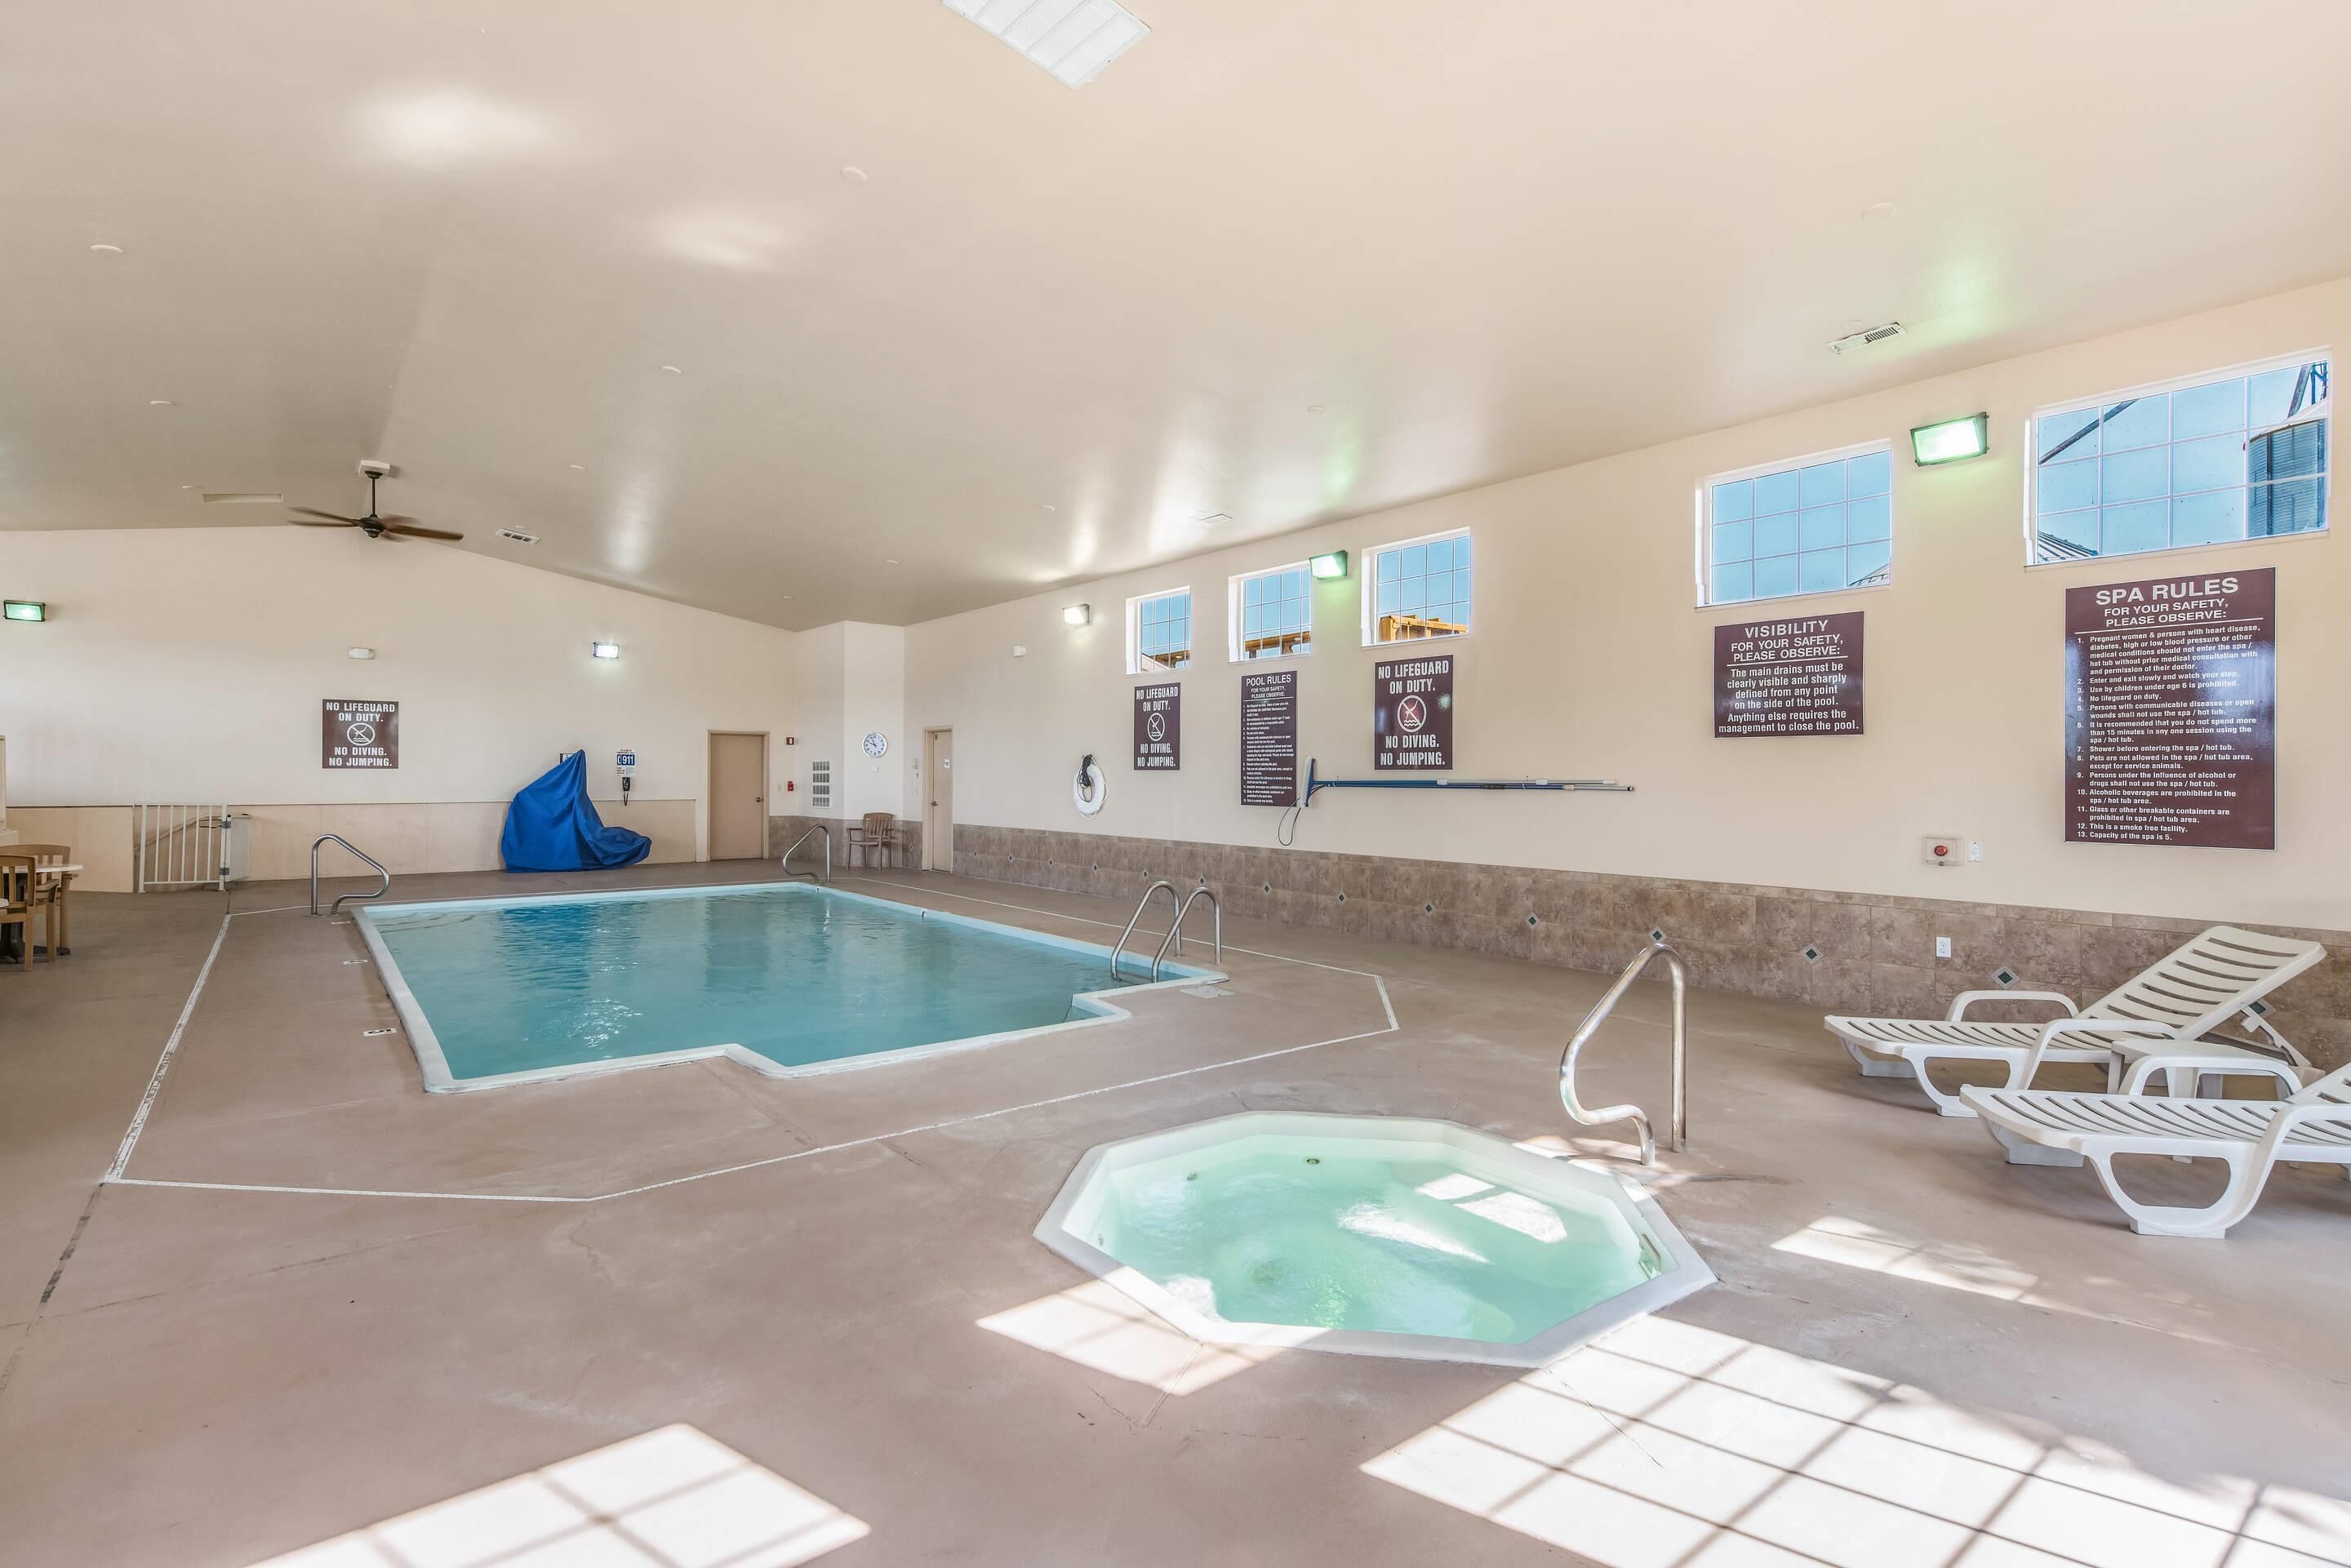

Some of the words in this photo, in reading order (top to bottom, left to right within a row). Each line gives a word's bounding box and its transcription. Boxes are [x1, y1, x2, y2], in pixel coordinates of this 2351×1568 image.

[2095, 587, 2144, 605] SPA
[2153, 577, 2238, 600] RULES
[2104, 607, 2129, 617] FOR
[2133, 603, 2169, 614] YOUR
[2173, 598, 2228, 611] SAFETY,
[2106, 615, 2155, 627] PLEASE
[2158, 610, 2226, 623] OBSERVE:
[1744, 620, 1829, 638] VISIBILITY
[2090, 634, 2120, 642] Pregnant
[2157, 630, 2185, 638] persons
[1731, 642, 1753, 652] FOR
[1758, 638, 1789, 650] YOUR
[1794, 633, 1843, 646] SAFETY,
[2187, 637, 2220, 645] pressure
[1734, 651, 1775, 662] PLEASE
[1780, 645, 1840, 659] OBSERVE:
[1378, 665, 1390, 679] NO
[1395, 660, 1449, 677] LIFEGUARD
[1731, 669, 1746, 677] The
[1749, 667, 1771, 677] main
[1774, 664, 1802, 675] drains
[1806, 663, 1829, 673] must
[1832, 662, 1843, 671] be
[2104, 666, 2143, 675] permission
[1247, 677, 1265, 686] POOL
[1267, 674, 1291, 685] RULES
[1389, 681, 1402, 694] ON
[1407, 678, 1435, 693] DUTY.
[1727, 678, 1756, 689] clearly
[1758, 677, 1789, 686] visible
[1791, 675, 1808, 685] and
[1811, 673, 1847, 685] sharply
[1136, 690, 1144, 700] NO
[1146, 686, 1178, 699] LIFEGUARD
[1735, 688, 1767, 700] defined
[1771, 688, 1791, 697] from
[1794, 688, 1811, 697] any
[1814, 684, 1838, 696] point
[2101, 694, 2131, 702] lifeguard
[327, 702, 340, 711] NO
[344, 703, 395, 713] LIFEGUARD
[1143, 701, 1151, 712] ON
[1153, 700, 1171, 711] DUTY.
[1748, 700, 1761, 708] the
[1763, 699, 1783, 708] side
[1785, 698, 1794, 707] of
[1797, 698, 1811, 707] the
[1815, 696, 1838, 708] pool.
[339, 713, 352, 722] ON
[356, 713, 383, 722] DUTY.
[1727, 712, 1765, 723] Anything
[1768, 711, 1786, 721] else
[1789, 710, 1829, 722] requires
[1831, 708, 1847, 718] the
[1718, 722, 1775, 734] management
[1777, 722, 1786, 731] to
[1789, 722, 1813, 731] close
[1815, 721, 1831, 731] the
[1834, 720, 1859, 731] pool.
[1140, 744, 1149, 753] NO
[1150, 743, 1172, 753] DIVING.
[1385, 735, 1398, 748] NO
[1402, 734, 1439, 748] DIVING.
[335, 747, 348, 755] NO
[352, 747, 387, 756] DIVING.
[329, 757, 342, 766] NO
[346, 757, 392, 766] JUMPING.
[622, 755, 633, 765] 911
[1137, 757, 1145, 766] NO
[1147, 757, 1176, 766] JUMPING.
[1380, 753, 1393, 766] NO
[1397, 752, 1445, 766] JUMPING.
[2161, 825, 2188, 833] facility.
